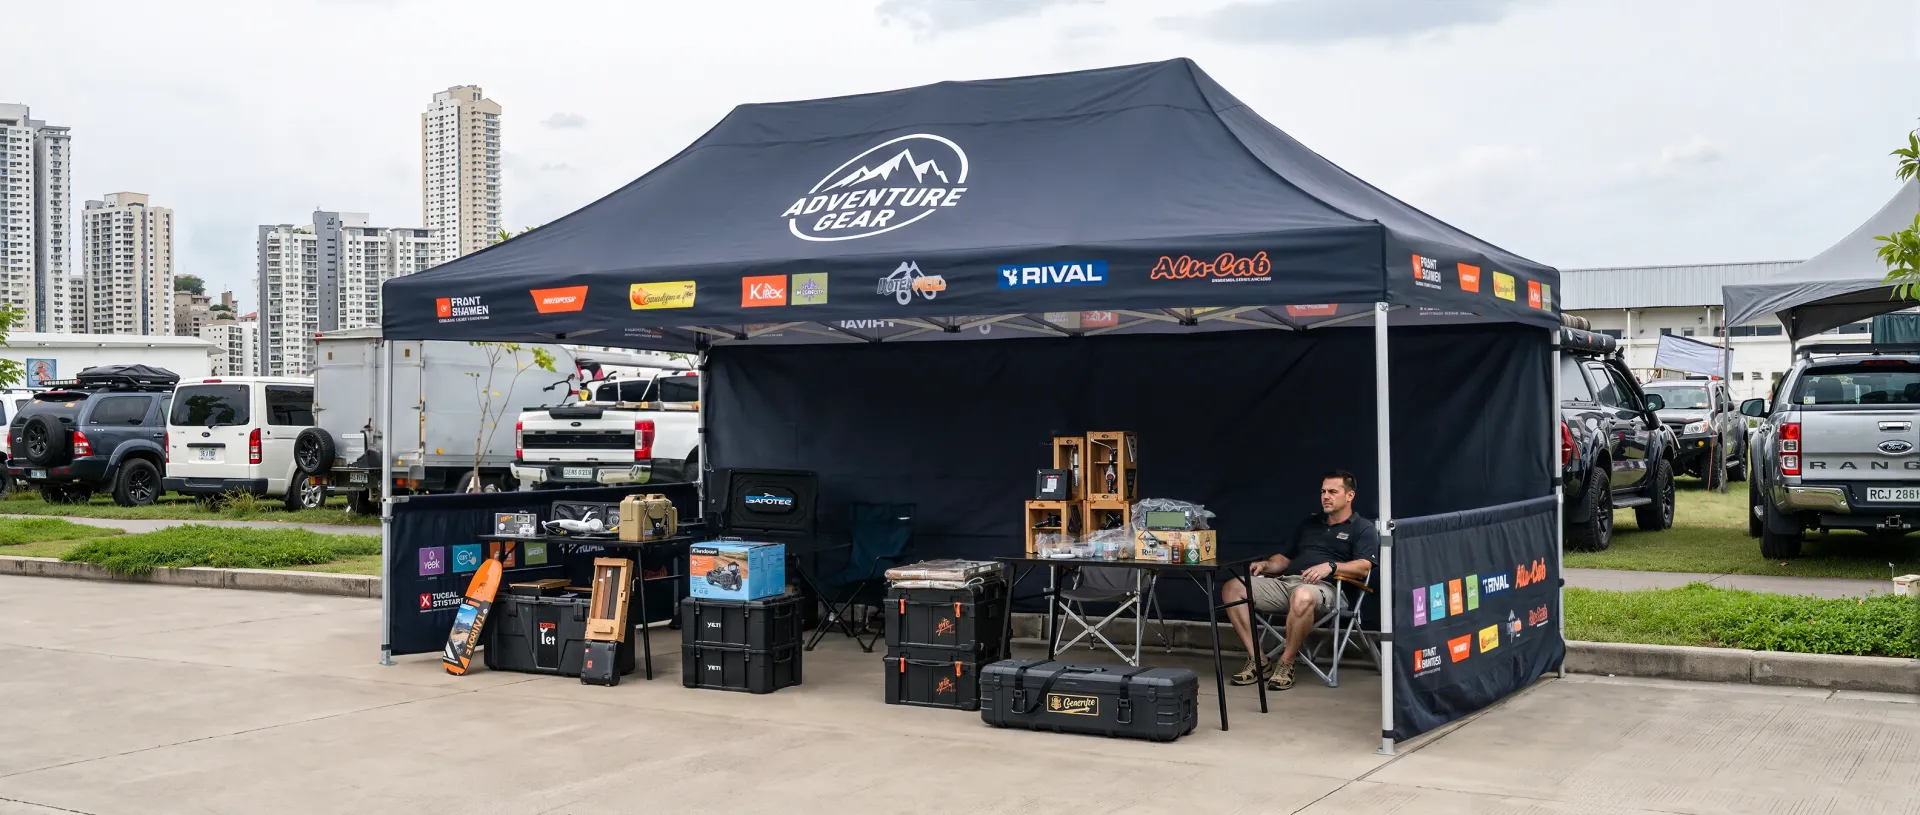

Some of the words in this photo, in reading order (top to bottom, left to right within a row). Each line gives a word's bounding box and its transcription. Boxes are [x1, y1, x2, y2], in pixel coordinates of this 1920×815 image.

[781, 188, 968, 217] ADVENTURE
[813, 209, 896, 231] GEAR
[1022, 264, 1102, 285] RIVAL
[1150, 251, 1271, 280] Alu-Cab
[1870, 490, 1892, 500] RCJ
